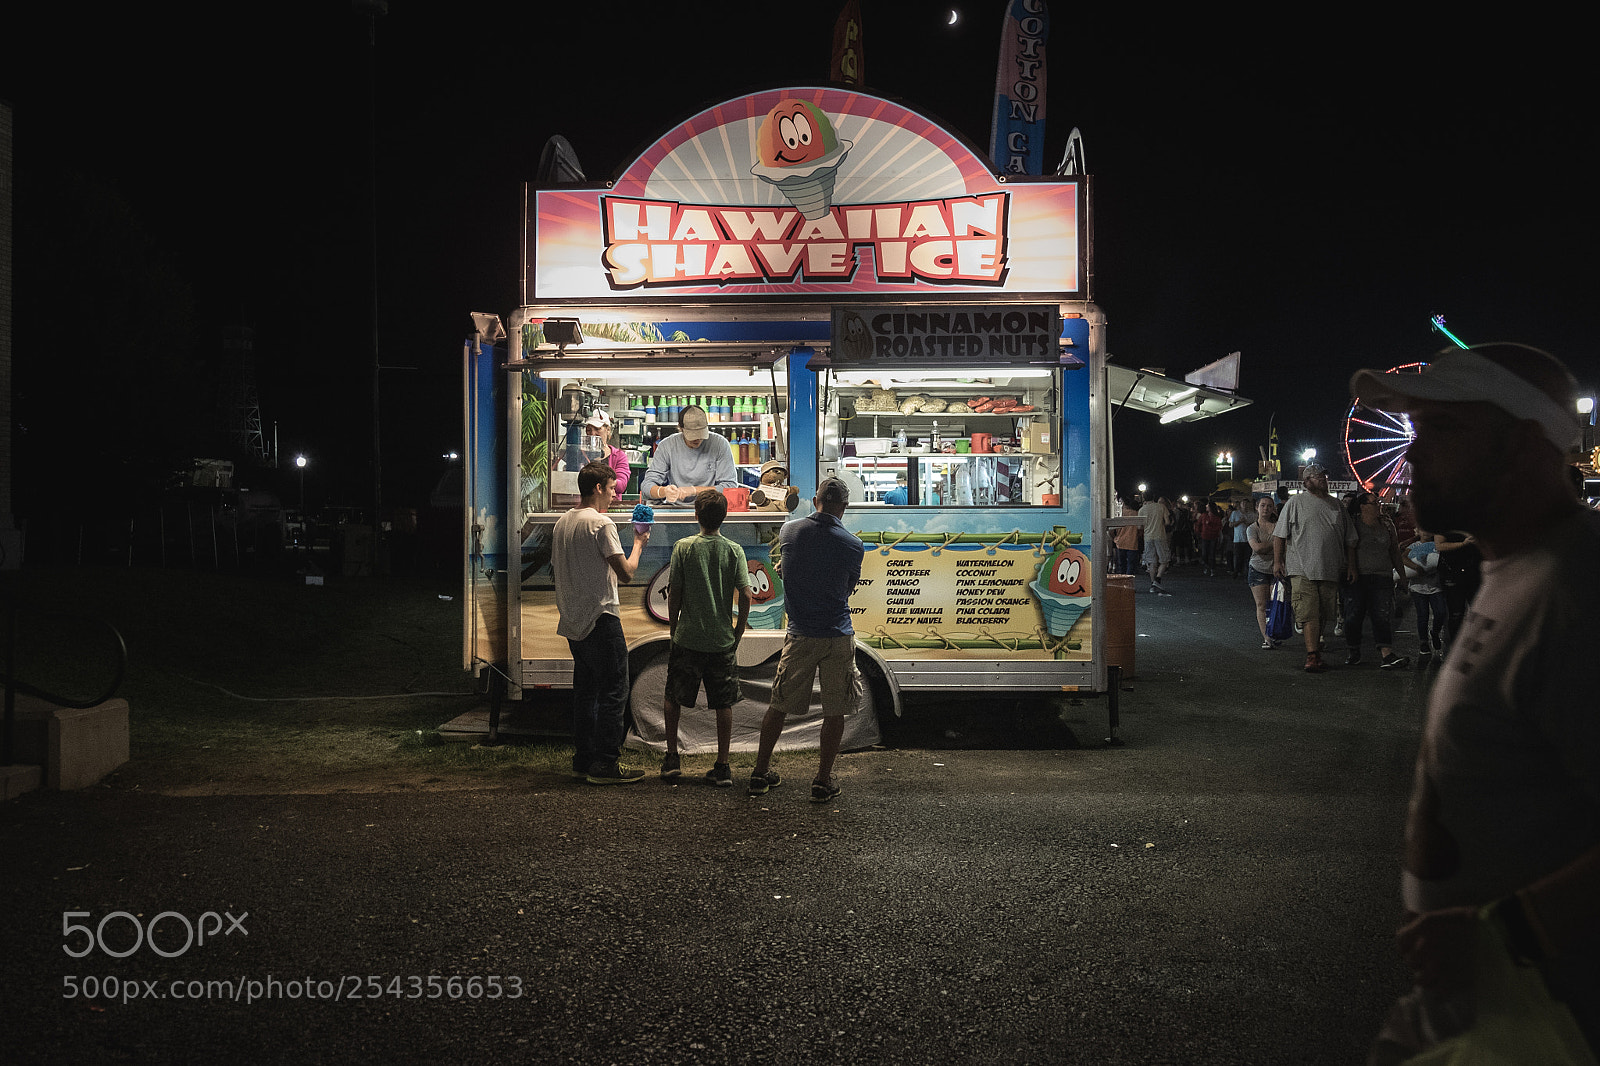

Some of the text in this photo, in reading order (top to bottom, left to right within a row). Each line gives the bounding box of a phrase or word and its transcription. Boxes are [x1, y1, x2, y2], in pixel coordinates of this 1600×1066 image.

[1006, 0, 1044, 124] COTTON
[609, 196, 1000, 242] HAWAIIAN
[606, 238, 999, 283] SHAVE ICE
[871, 311, 1050, 335] CINNAMON
[875, 333, 1050, 358] ROASTED NUTS
[1285, 481, 1302, 489] SALT
[1328, 481, 1352, 490] TAFFY
[886, 569, 931, 577] ROOTBEER
[956, 569, 997, 577] COCONUT
[886, 588, 921, 596] BANANA
[956, 588, 1006, 596] HONEY DEW
[995, 598, 1031, 606] ORANGE
[909, 607, 943, 615] VANILLA
[956, 607, 1011, 615] PINA COLADA
[886, 617, 943, 625] FUZZY NAVEL
[956, 617, 1011, 625] BLACKBERRY
